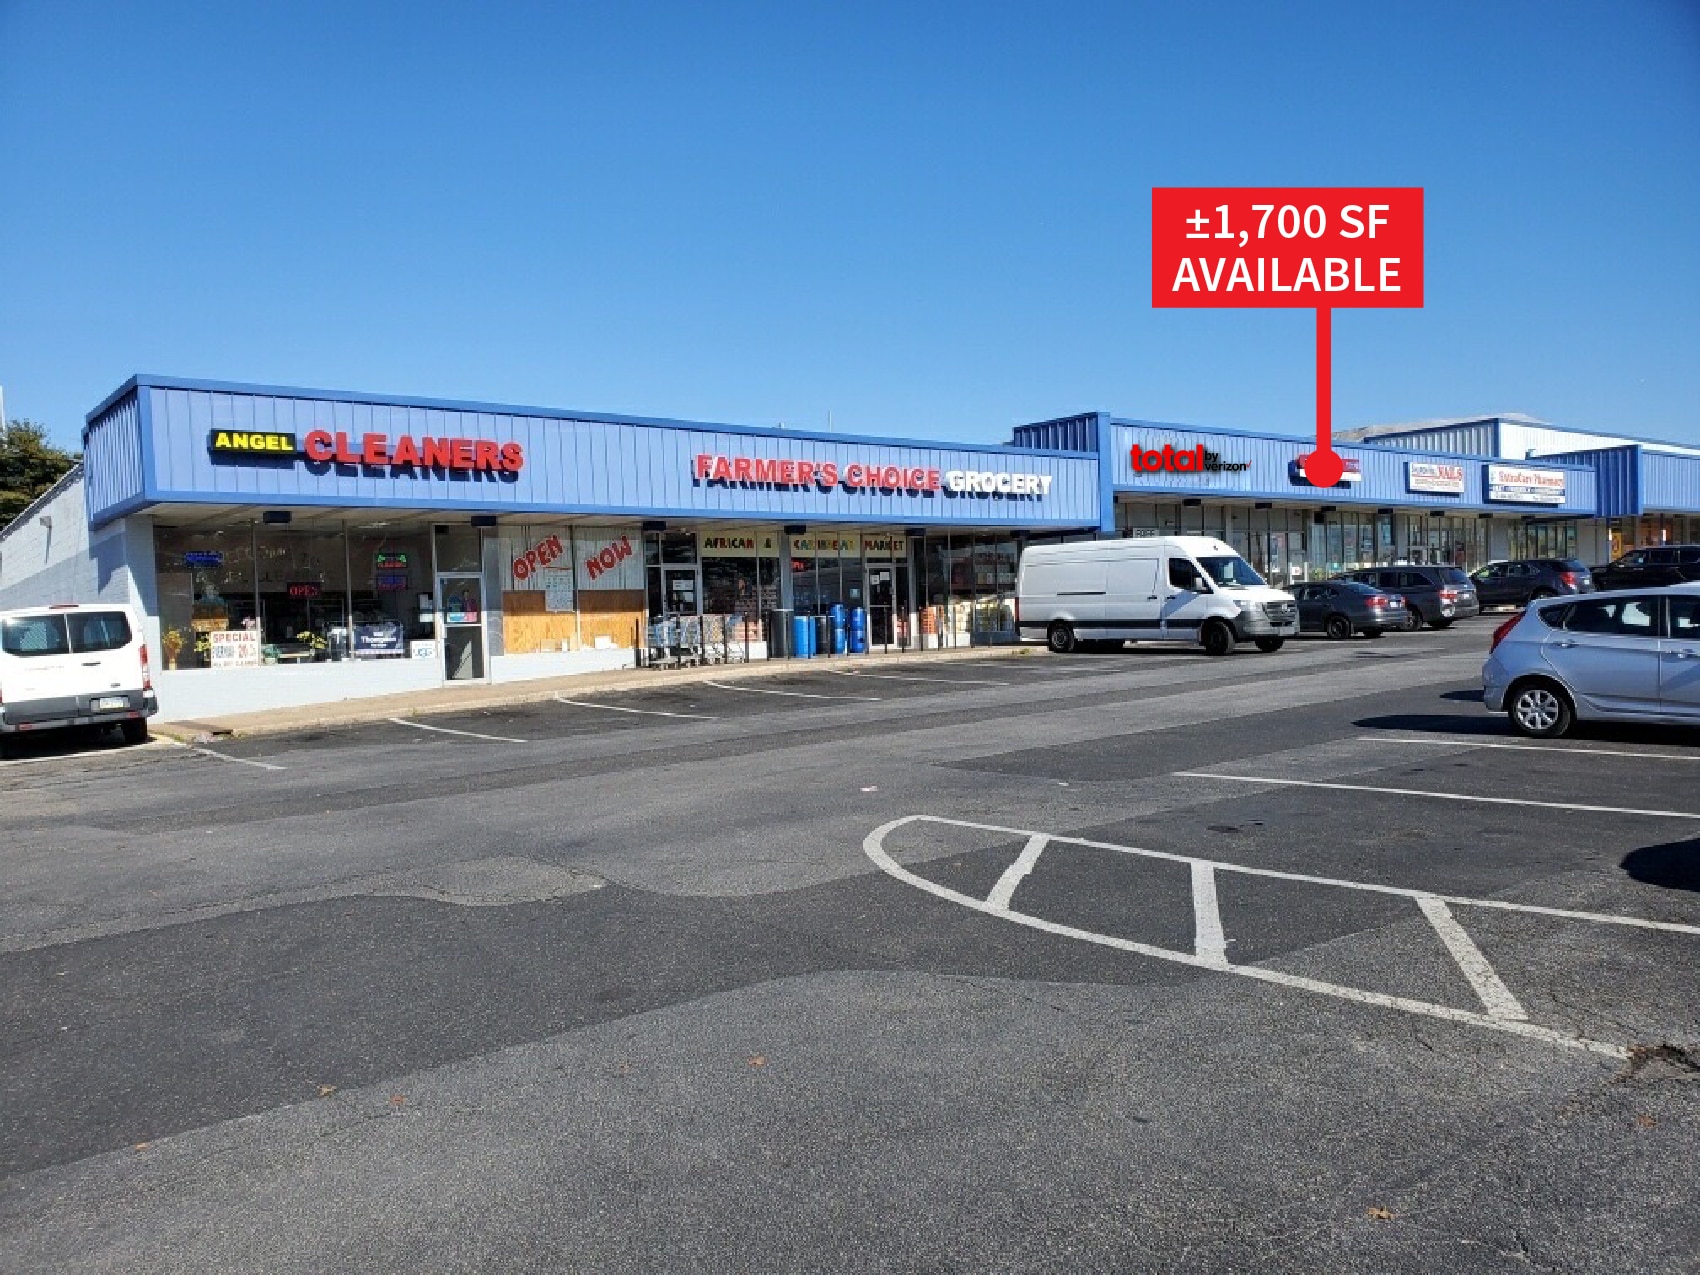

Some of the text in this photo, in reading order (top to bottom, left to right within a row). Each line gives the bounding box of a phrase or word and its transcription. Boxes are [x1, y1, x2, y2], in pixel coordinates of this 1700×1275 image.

[215, 432, 293, 451] ANGEL
[304, 430, 523, 471] CLEANERS
[1130, 444, 1204, 472] total
[1204, 450, 1218, 462] by
[696, 454, 1052, 494] FARMER'S CHOICE GROCERY
[1205, 460, 1247, 472] verizon
[705, 537, 755, 549] AFRICAN
[865, 539, 904, 551] MARKET
[513, 535, 632, 580] OPEN NOW
[213, 633, 256, 643] SPECIAL
